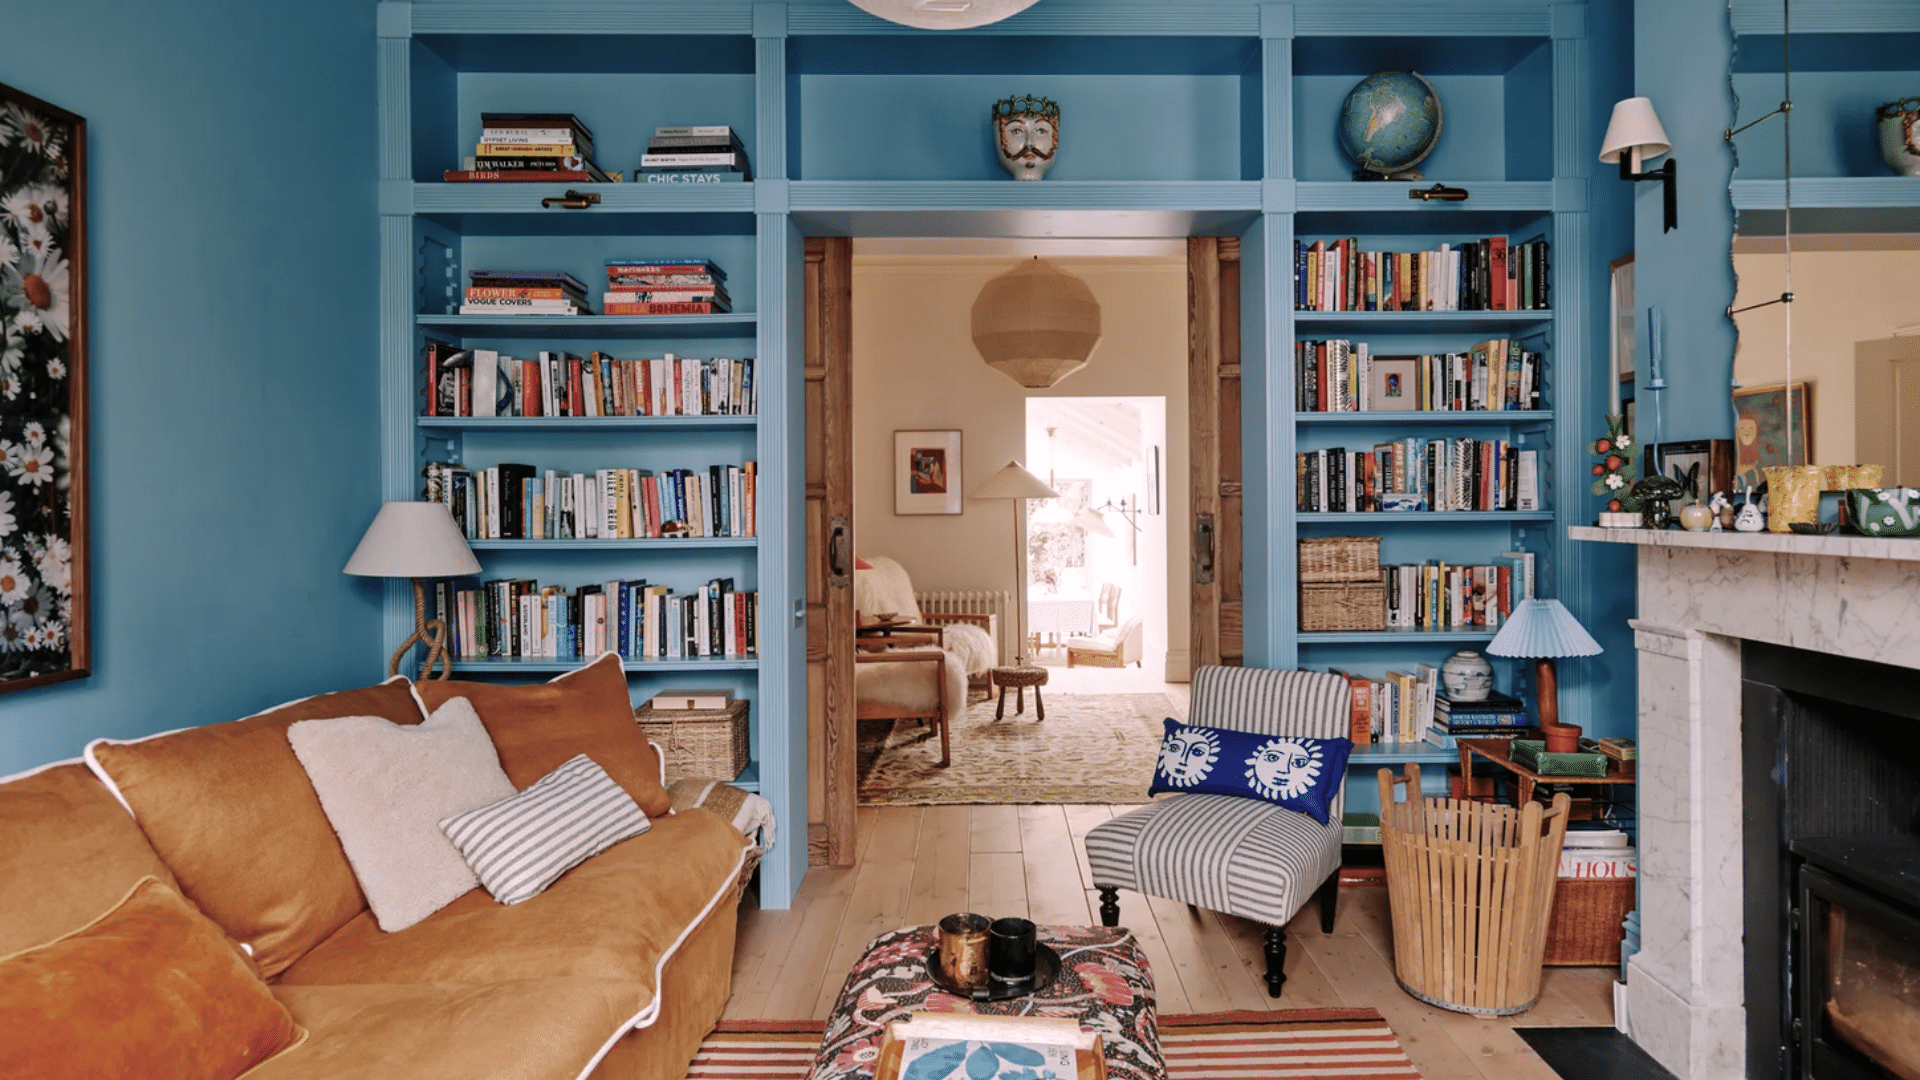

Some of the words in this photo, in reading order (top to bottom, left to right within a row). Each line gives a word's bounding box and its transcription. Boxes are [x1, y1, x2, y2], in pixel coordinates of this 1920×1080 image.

[468, 171, 500, 180] BIRDS
[647, 174, 679, 183] CHIC
[682, 174, 721, 183] STAYS
[469, 288, 516, 298] FLOWER
[467, 298, 497, 306] VOGUE
[499, 298, 532, 307] COVERS
[607, 471, 617, 498] KILEY
[608, 509, 617, 531] REID
[1576, 861, 1636, 879] HOUS
